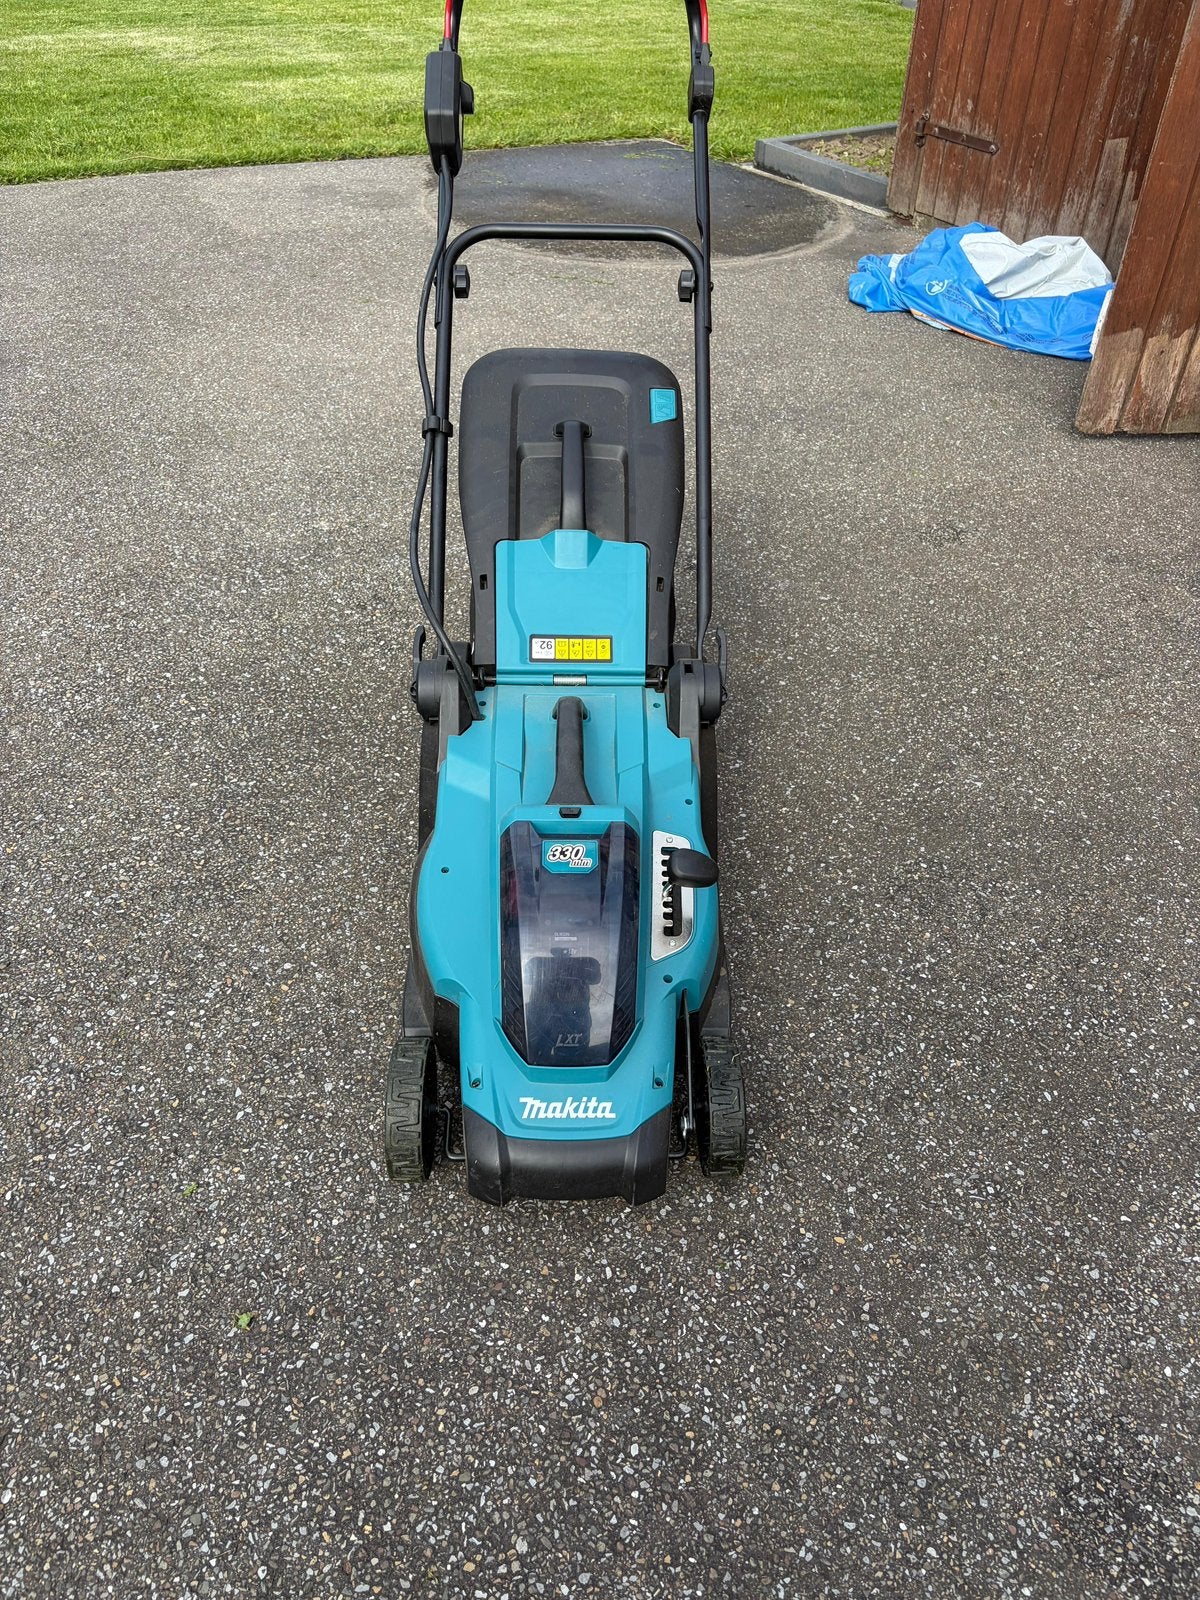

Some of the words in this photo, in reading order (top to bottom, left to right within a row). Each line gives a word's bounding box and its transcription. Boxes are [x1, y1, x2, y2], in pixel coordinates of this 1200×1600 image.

[540, 640, 553, 650] 92
[547, 844, 585, 862] 330
[570, 858, 592, 867] mm
[556, 1033, 582, 1047] LXT
[519, 1096, 617, 1119] Makita
